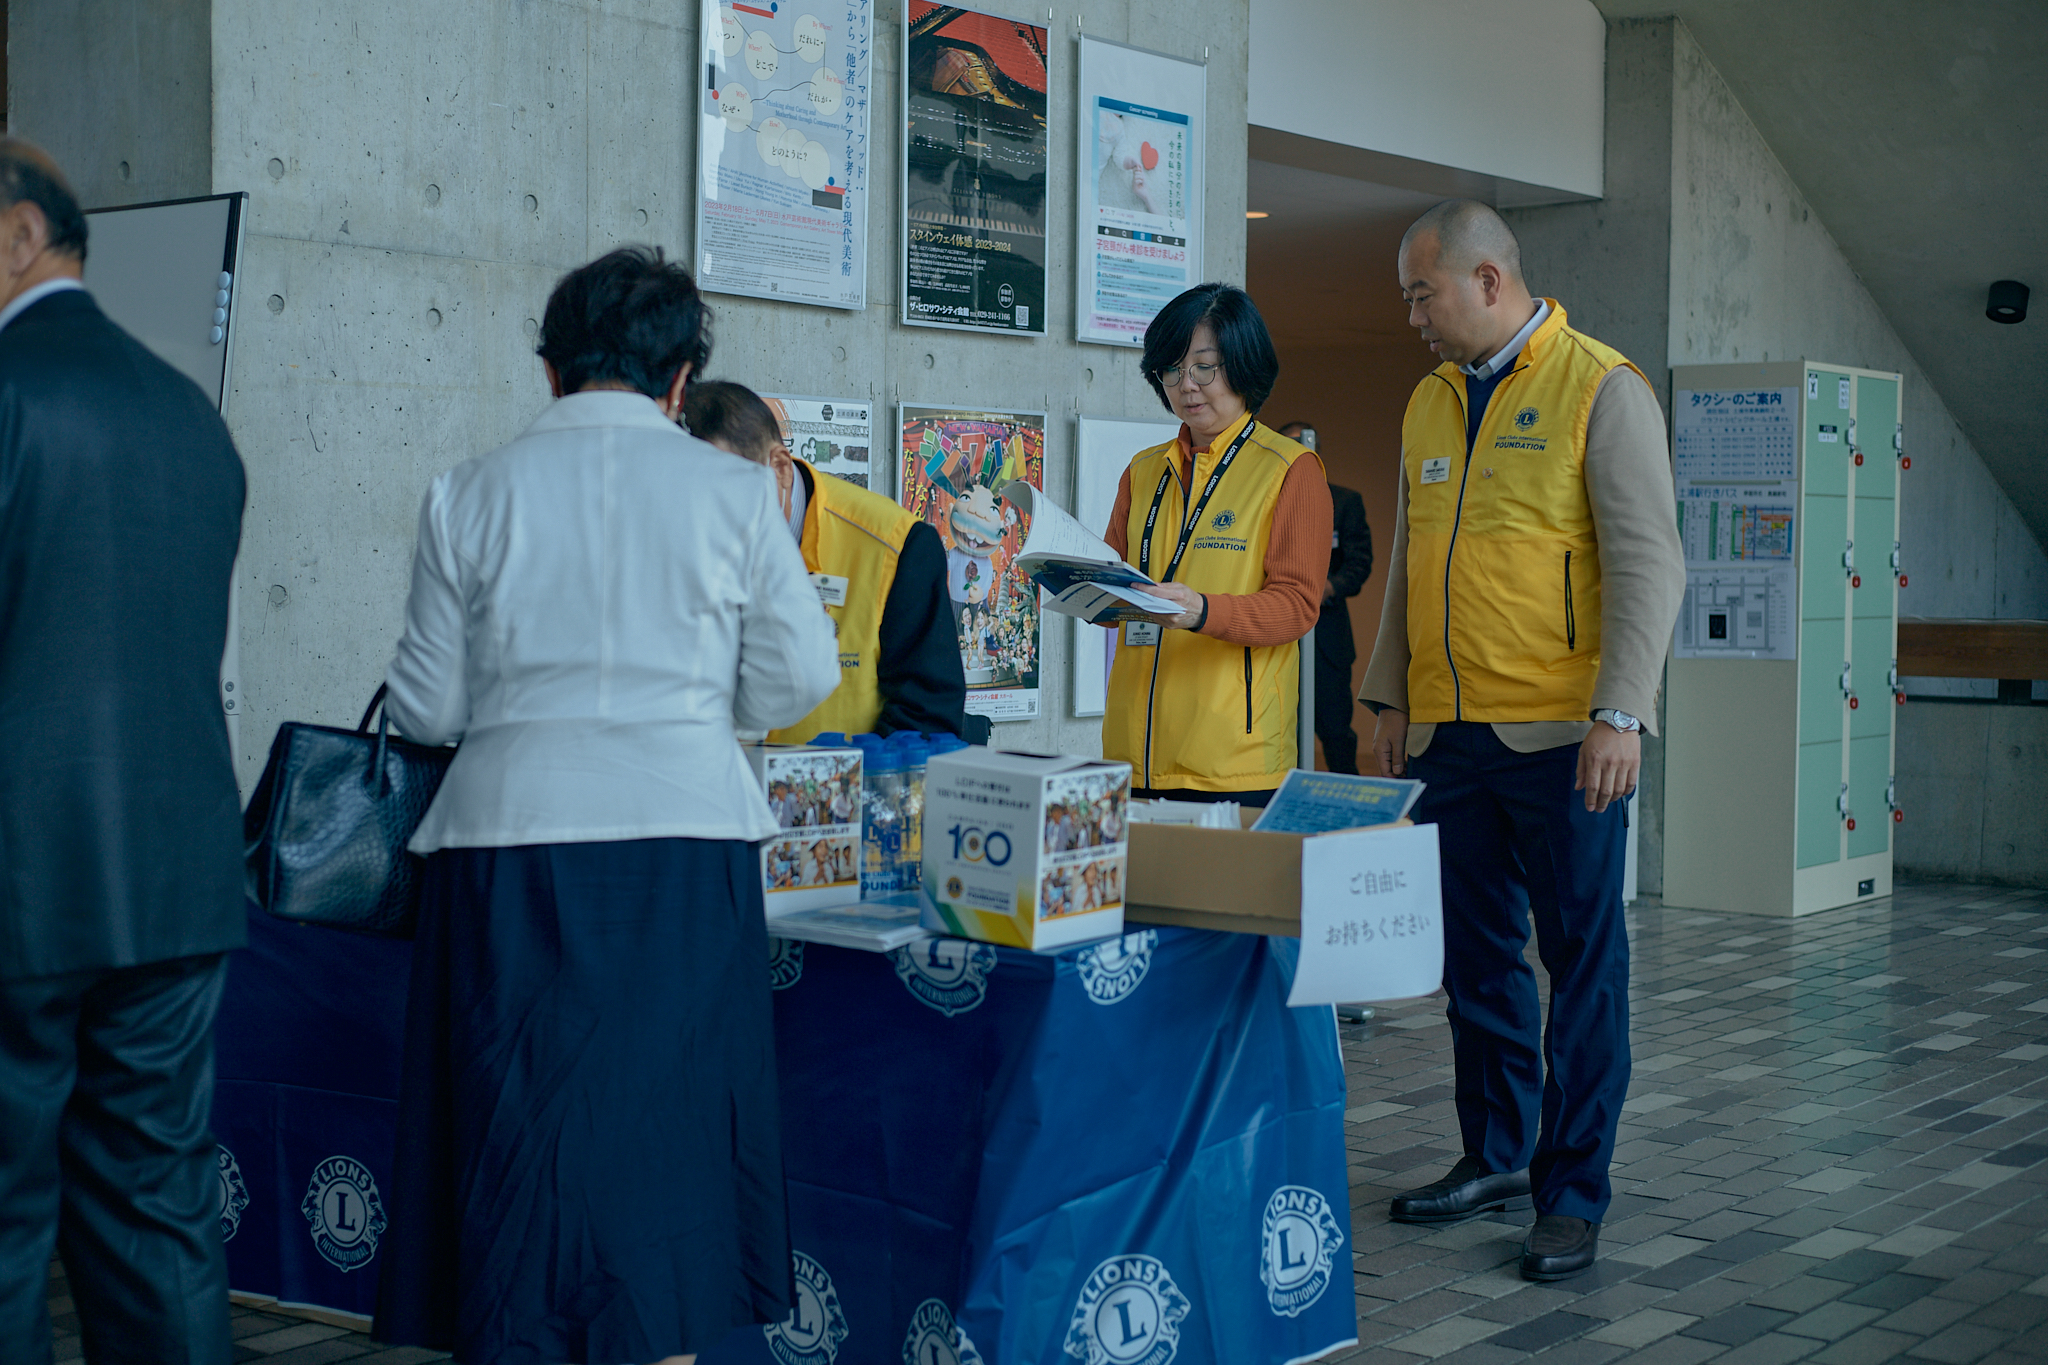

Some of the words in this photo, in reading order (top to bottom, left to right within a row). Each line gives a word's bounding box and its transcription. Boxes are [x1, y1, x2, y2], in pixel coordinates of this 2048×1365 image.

[909, 228, 973, 248] スタインウェイ体感
[975, 238, 1012, 253] 2023-2024
[1096, 238, 1186, 262] 子宮頸がん検診を受けましょう
[1691, 392, 1782, 408] タクシーのご案内
[948, 422, 967, 433] NEW
[970, 423, 1003, 437] WAHAHA
[1241, 421, 1255, 439] CICON
[1523, 414, 1531, 424] L
[1221, 444, 1238, 466] LCICON
[1494, 441, 1546, 451] FOUNDATION
[1204, 474, 1219, 497] LCICON
[1146, 506, 1157, 528] LCICON
[1188, 507, 1202, 531] LCICON
[1220, 516, 1226, 525] L
[1173, 541, 1186, 565] LCICON
[1193, 542, 1246, 552] FOUNDATION
[1349, 869, 1407, 896] ご自由に
[1325, 913, 1431, 947] お持ちください
[1094, 955, 1145, 999] LIONS
[320, 1160, 370, 1190] LIONS
[336, 1191, 356, 1232] L
[1265, 1191, 1319, 1233] LIONS
[320, 1237, 370, 1263] INTERNATIONAL
[1277, 1227, 1306, 1271] L
[1083, 1259, 1160, 1301] LIONS
[920, 1304, 957, 1346] LIONS
[1112, 1299, 1148, 1348] L
